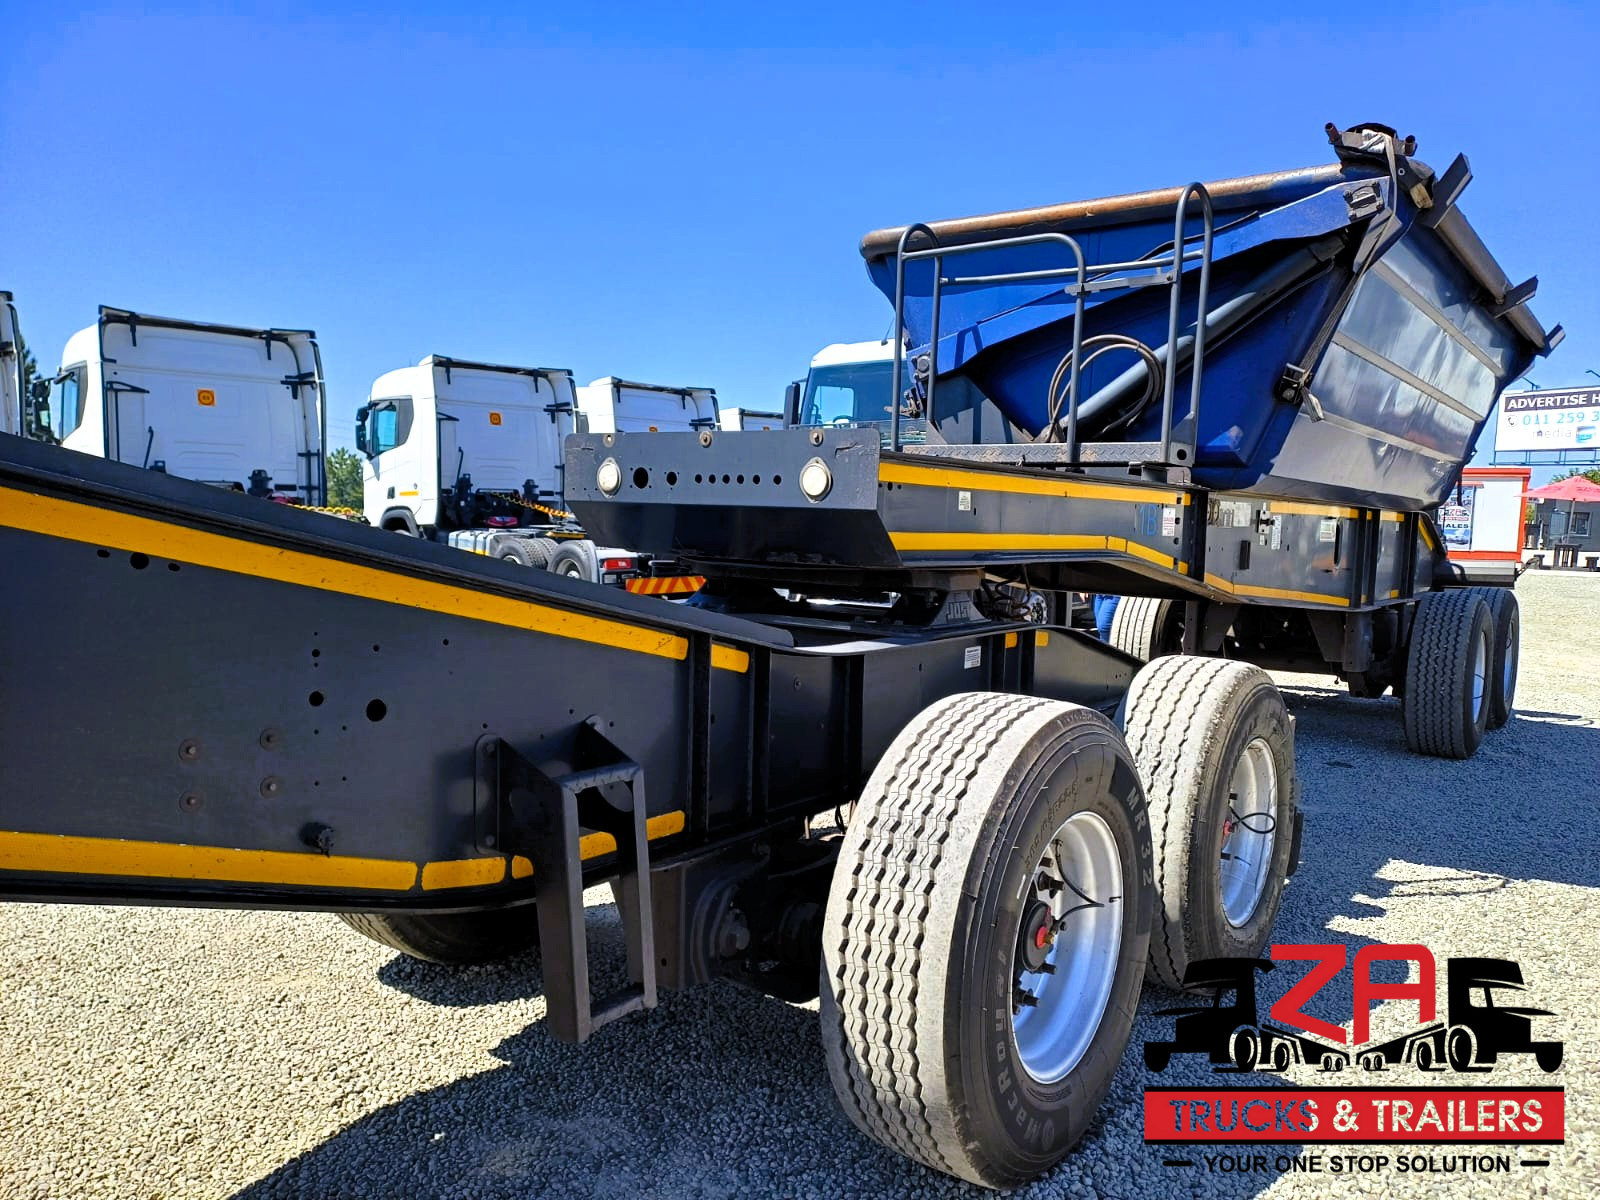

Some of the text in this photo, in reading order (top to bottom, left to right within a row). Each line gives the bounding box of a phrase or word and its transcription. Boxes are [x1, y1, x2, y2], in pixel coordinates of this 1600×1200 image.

[1507, 394, 1588, 409] ADVERTISE
[1522, 413, 1550, 426] 011
[1556, 411, 1585, 424] 259
[1139, 502, 1158, 537] 1B
[1126, 786, 1153, 886] MR 32
